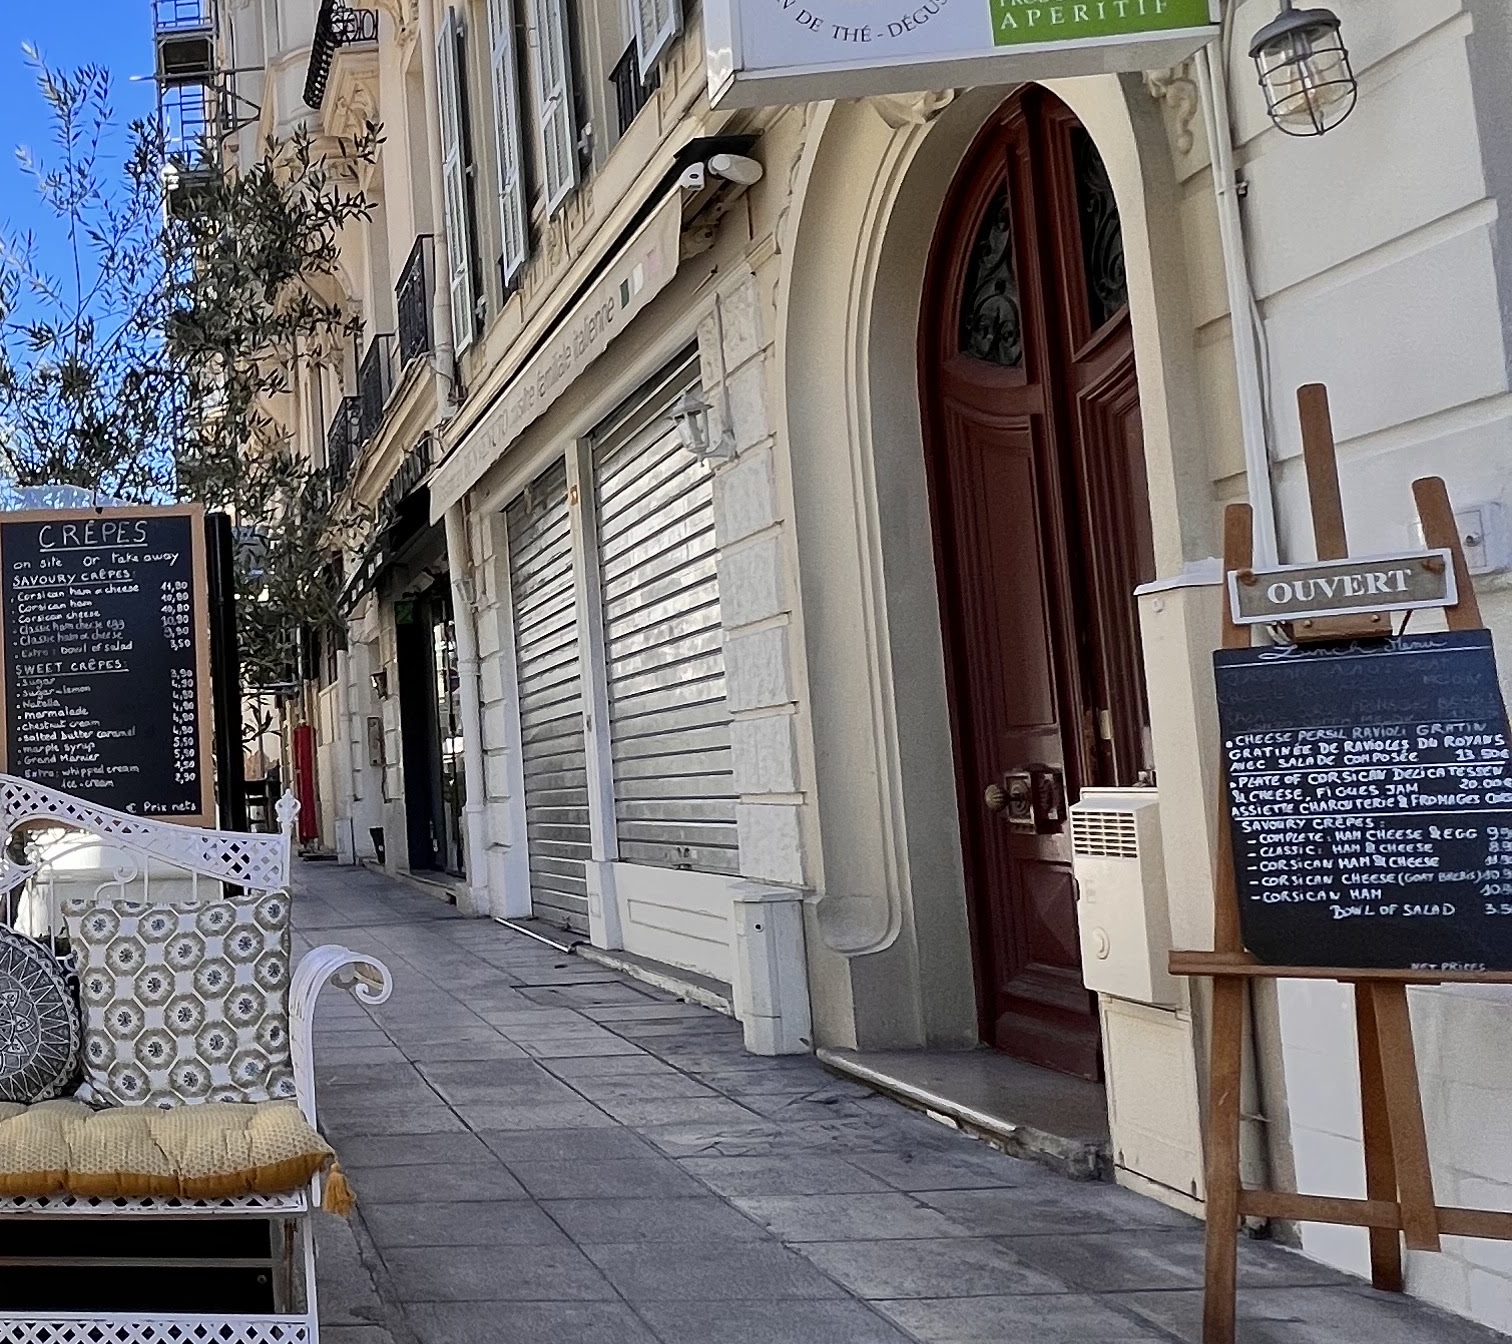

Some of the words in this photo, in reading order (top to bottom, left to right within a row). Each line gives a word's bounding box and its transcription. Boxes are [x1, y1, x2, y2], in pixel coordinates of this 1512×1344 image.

[796, 9, 824, 32] DE
[832, 25, 872, 42] THÉ
[13, 561, 31, 570] on
[40, 556, 63, 568] site
[111, 551, 139, 564] take
[143, 552, 179, 567] away
[13, 574, 76, 587] SAVOURY
[1267, 569, 1412, 604] OUVERT
[17, 590, 65, 602] Corsican
[69, 586, 92, 595] ham
[18, 602, 66, 613] Corsican
[69, 599, 92, 607] ham
[18, 613, 62, 624] Corsican
[60, 643, 86, 654] bowl
[91, 642, 102, 652] of
[103, 640, 133, 652] salad
[15, 661, 63, 675] SWEET
[24, 706, 89, 720] marmalade
[22, 720, 66, 731] chestnut
[23, 730, 57, 741] salted
[61, 728, 93, 740] butter
[96, 725, 136, 738] caramel
[1235, 732, 1292, 746] CHEESE
[1416, 723, 1487, 736] GRATIN
[64, 741, 96, 754] syrup
[1318, 742, 1339, 753] DE
[23, 755, 56, 765] Grand
[1230, 760, 1266, 772] AVEC
[1278, 755, 1335, 768] SALADE
[1238, 775, 1280, 788] PLATE
[1284, 774, 1302, 785] OF
[1385, 782, 1418, 795] JAM
[143, 801, 166, 812] Prix
[171, 801, 196, 811] nets
[1335, 830, 1362, 842] HAM
[1366, 829, 1423, 841] CHEESE
[1443, 828, 1478, 839] EGG
[1332, 844, 1361, 855] HAM
[1379, 842, 1434, 853] CHEESE
[1259, 856, 1334, 872] CORSICAN
[1338, 855, 1371, 869] HAM
[1388, 856, 1440, 868] CHEESE
[1261, 872, 1334, 887] CORSICAN
[1262, 889, 1340, 904] CORSICAN
[1349, 888, 1382, 901] HAM
[1329, 904, 1375, 919] BOWL
[1379, 904, 1399, 916] OF
[1402, 903, 1456, 916] SALAD
